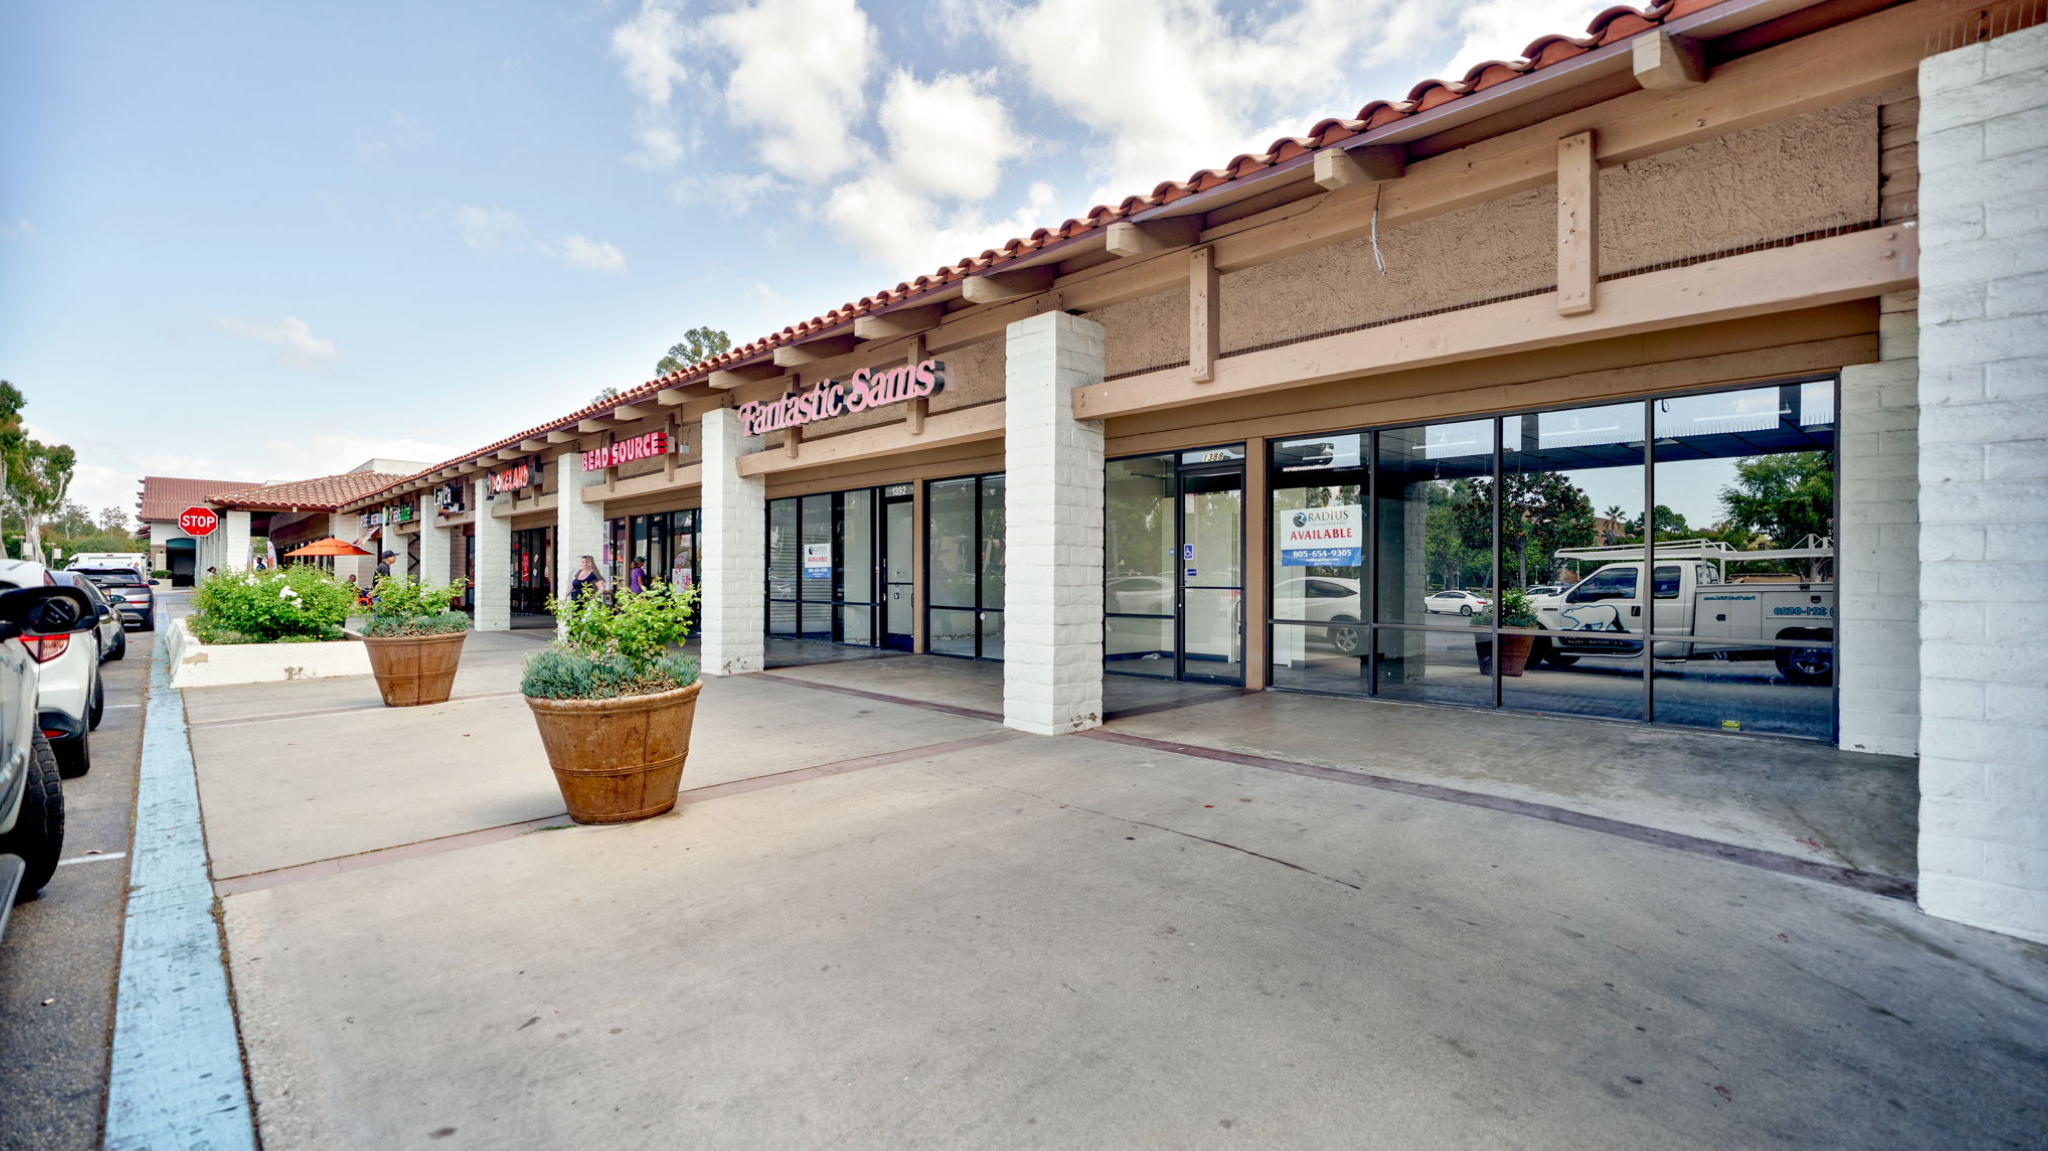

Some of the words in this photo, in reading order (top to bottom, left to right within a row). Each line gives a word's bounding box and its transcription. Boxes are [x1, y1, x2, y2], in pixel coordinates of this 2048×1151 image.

[738, 378, 845, 437] Fantastic
[847, 360, 937, 413] Sams
[582, 450, 608, 472] BEAD
[612, 432, 659, 465] SOURCE
[1202, 452, 1224, 462] 1388
[892, 485, 906, 496] 1392
[182, 515, 215, 528] STOP
[1308, 510, 1349, 522] RADIUS
[1290, 528, 1352, 541] AVAILABLE
[1293, 549, 1352, 558] 805-654-9305
